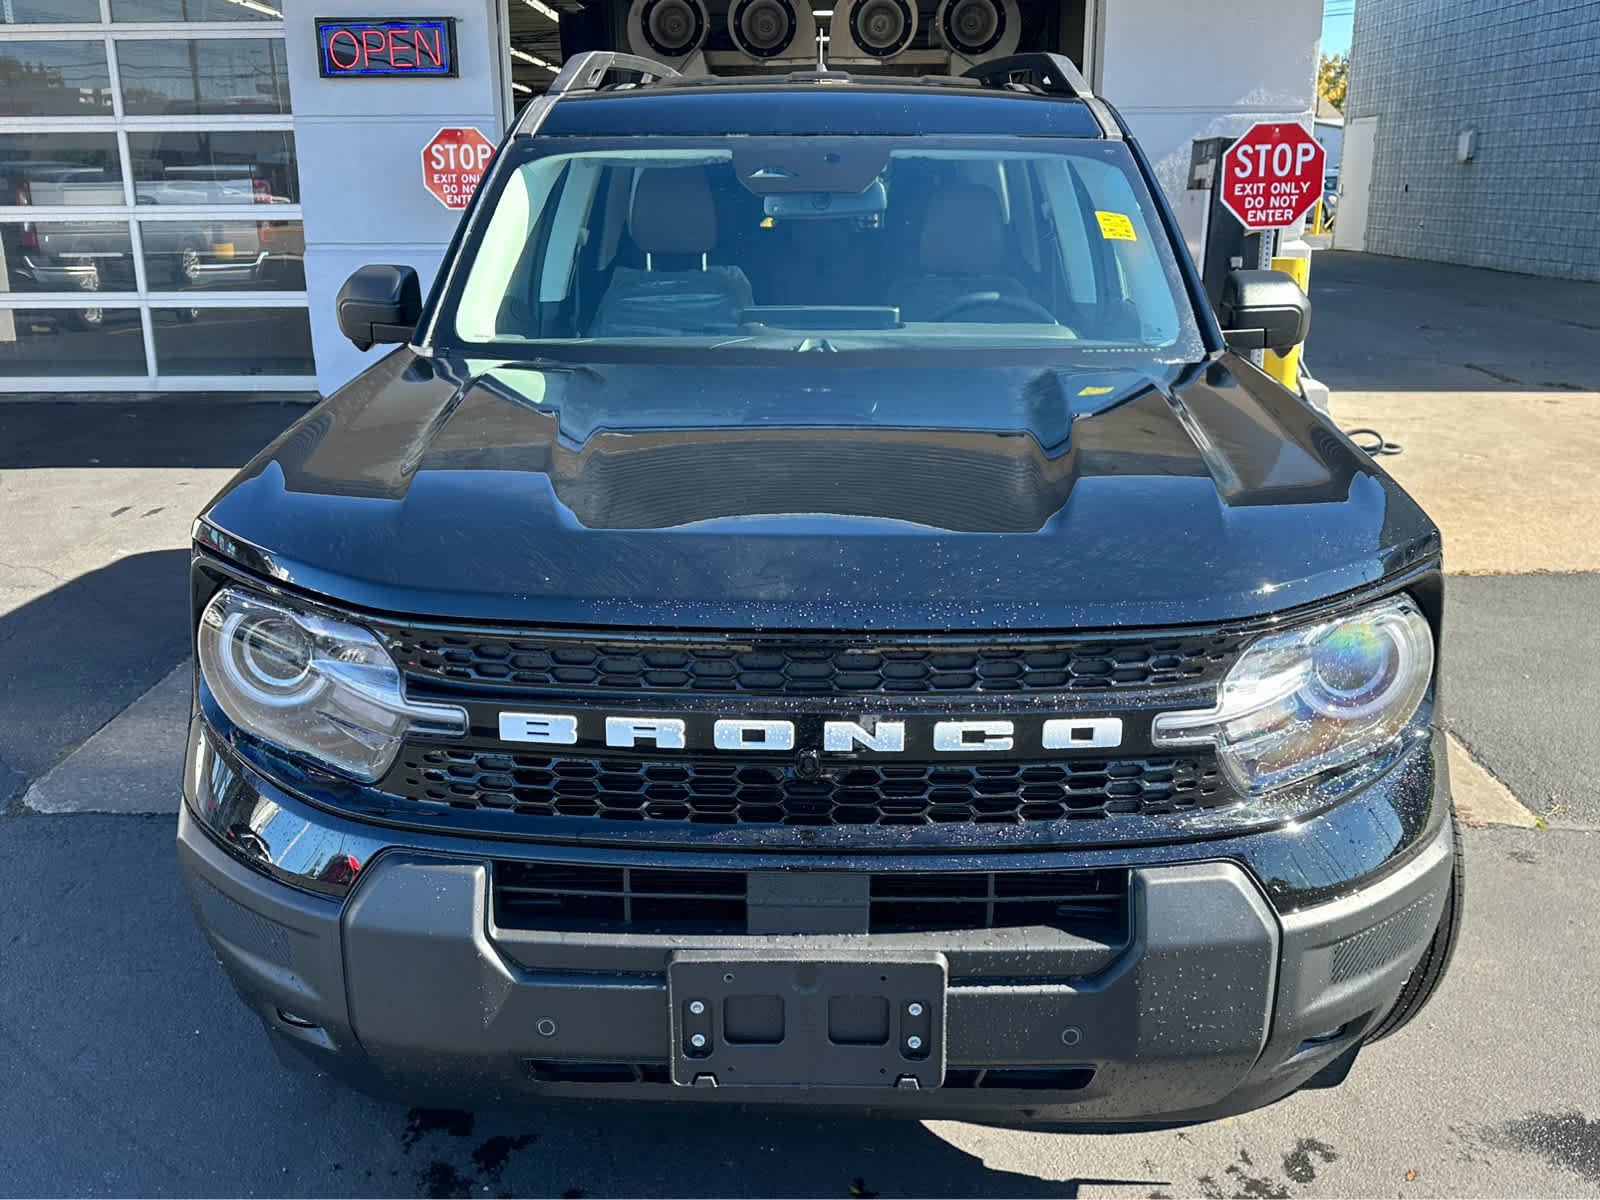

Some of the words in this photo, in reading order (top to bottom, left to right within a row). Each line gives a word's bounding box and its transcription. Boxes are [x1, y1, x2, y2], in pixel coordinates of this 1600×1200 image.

[329, 29, 441, 69] OPEN
[431, 144, 492, 170] STOP
[1234, 143, 1315, 178] STOP
[433, 174, 457, 184] EXIT
[461, 174, 481, 183] ON
[443, 184, 458, 194] DO
[462, 184, 477, 194] NO
[1234, 183, 1266, 196] EXIT
[1270, 181, 1311, 194] ONLY
[446, 194, 472, 204] ENT
[1244, 196, 1265, 209] DO
[1269, 195, 1299, 208] NOT
[1247, 208, 1294, 222] ENTER
[498, 711, 1123, 751] BRONCO
